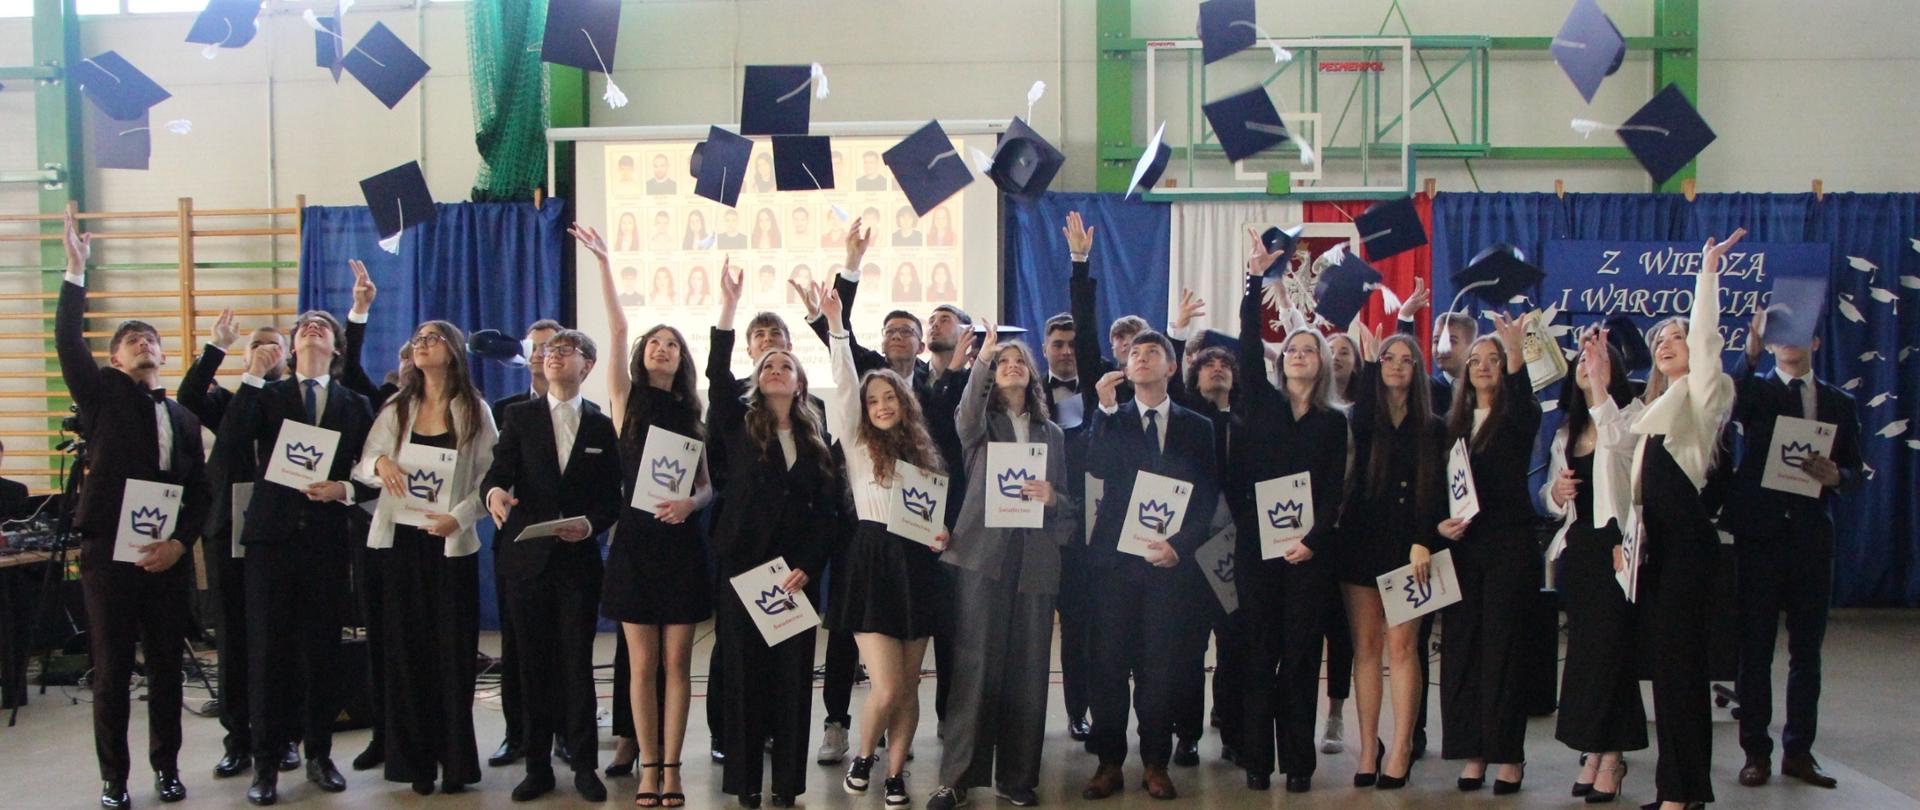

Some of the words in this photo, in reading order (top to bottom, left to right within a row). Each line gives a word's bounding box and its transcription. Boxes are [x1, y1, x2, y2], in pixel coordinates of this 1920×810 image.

[1597, 250, 1621, 275] Z
[1557, 288, 1573, 312] I
[1581, 283, 1773, 318] WARTOCIA
